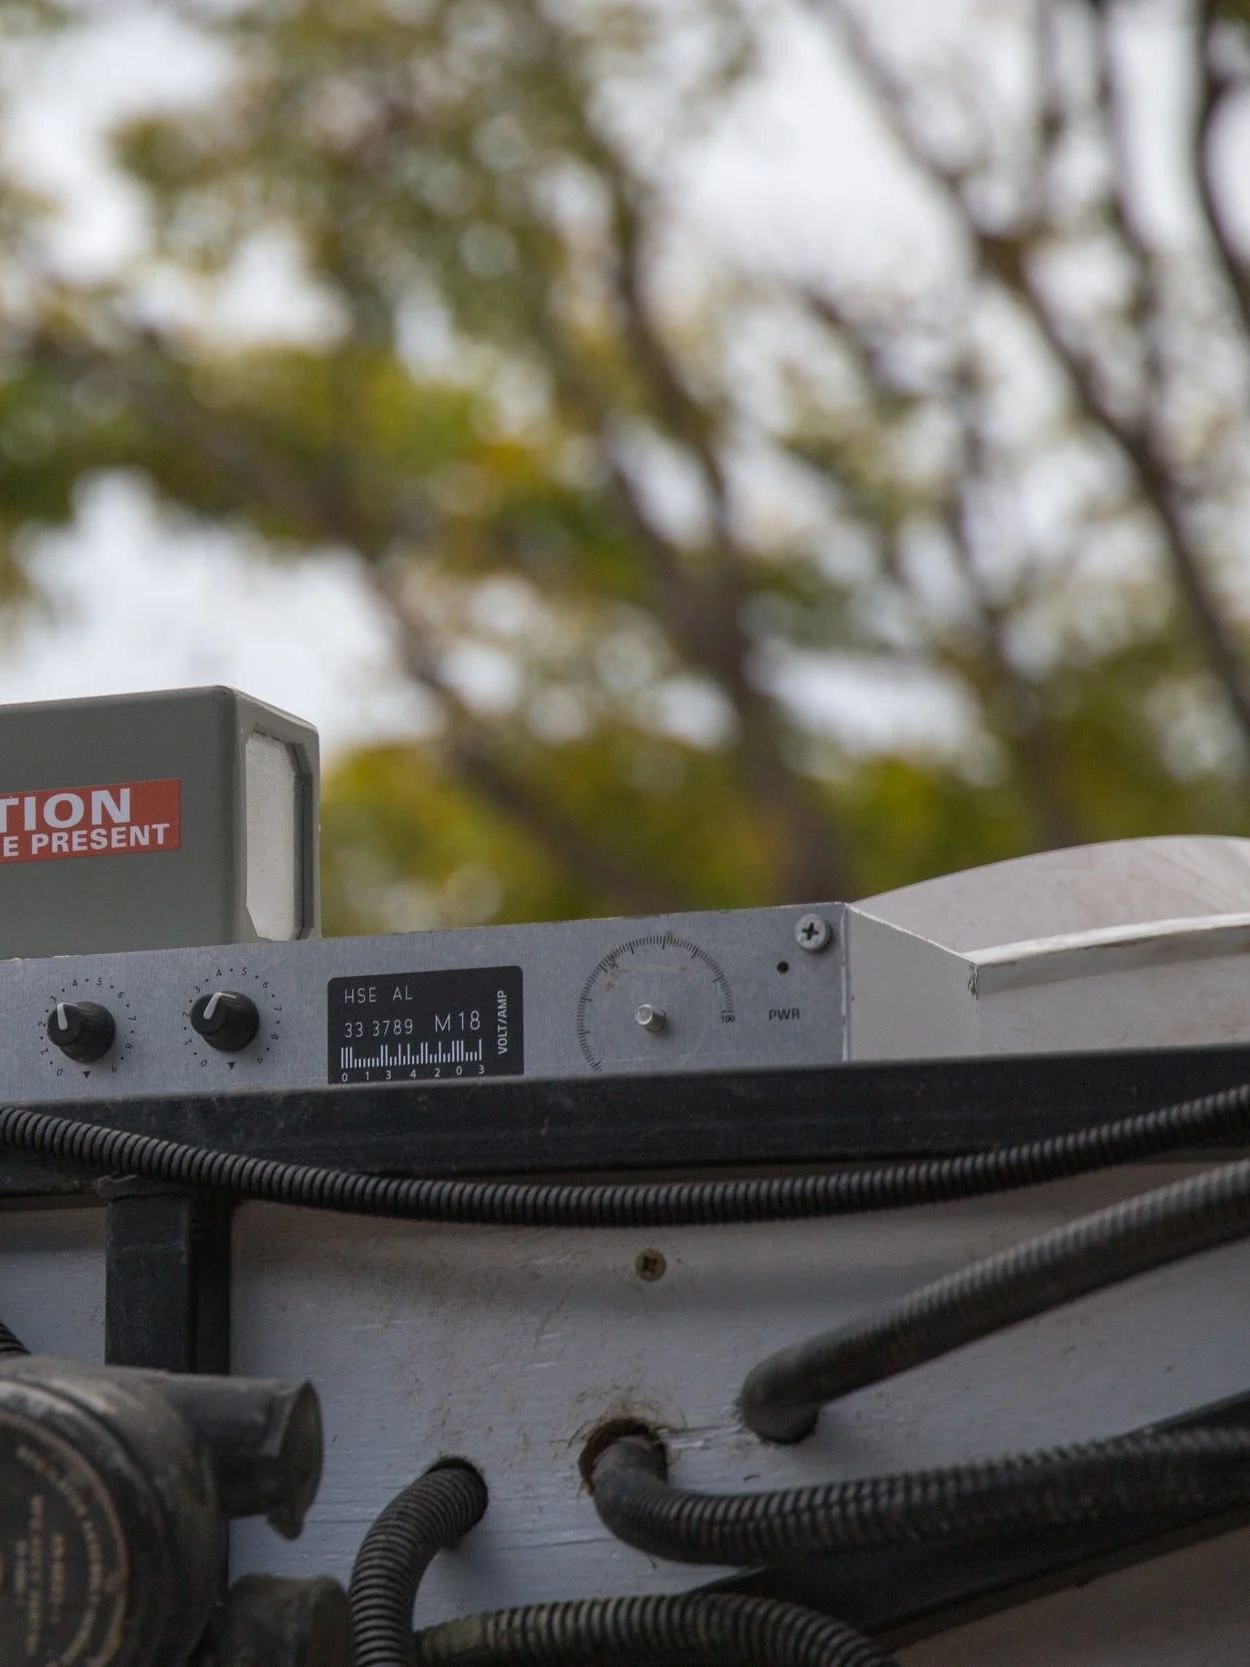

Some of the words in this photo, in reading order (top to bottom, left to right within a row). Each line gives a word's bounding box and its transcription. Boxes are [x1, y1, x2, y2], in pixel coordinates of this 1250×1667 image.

[31, 822, 170, 856] PRESENT
[344, 987, 377, 1004] HSE
[393, 984, 413, 1001] AL
[497, 990, 507, 1055] VOLT/AMP
[720, 1014, 735, 1023] 100
[768, 1008, 800, 1021] PWR
[372, 1018, 413, 1037] 3789
[341, 1072, 348, 1082] 0
[366, 1071, 370, 1081] 1
[385, 1070, 392, 1080] 3
[410, 1069, 417, 1079] 4
[434, 1068, 440, 1078] 2
[456, 1065, 463, 1076] 0
[478, 1065, 485, 1075] 3
